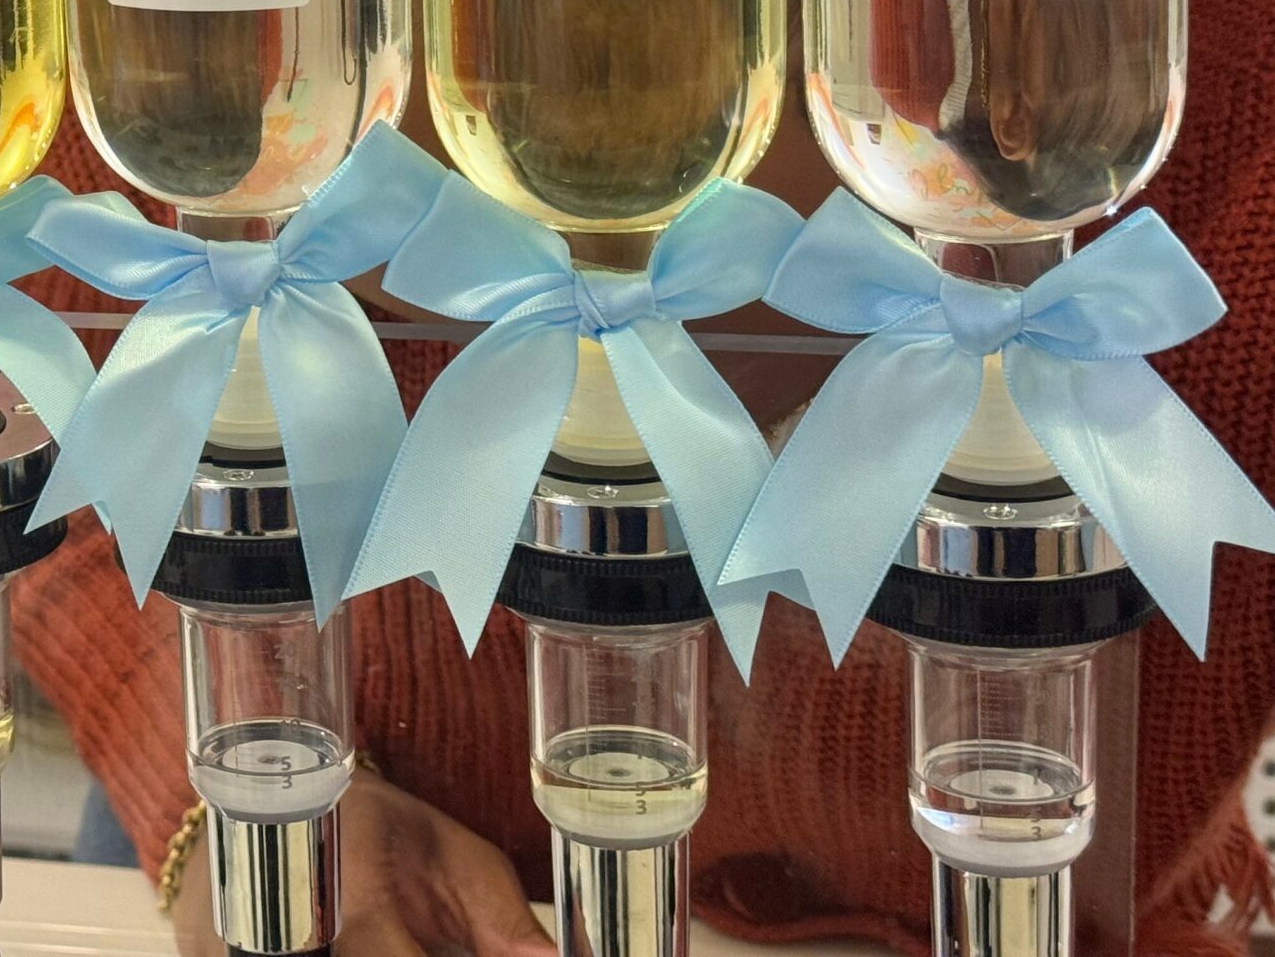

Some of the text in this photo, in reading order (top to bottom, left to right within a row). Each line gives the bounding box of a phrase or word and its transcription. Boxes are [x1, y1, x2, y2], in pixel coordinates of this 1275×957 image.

[280, 756, 291, 771] 5
[281, 775, 293, 789] 3
[635, 800, 647, 815] 3
[1031, 826, 1042, 840] 3
